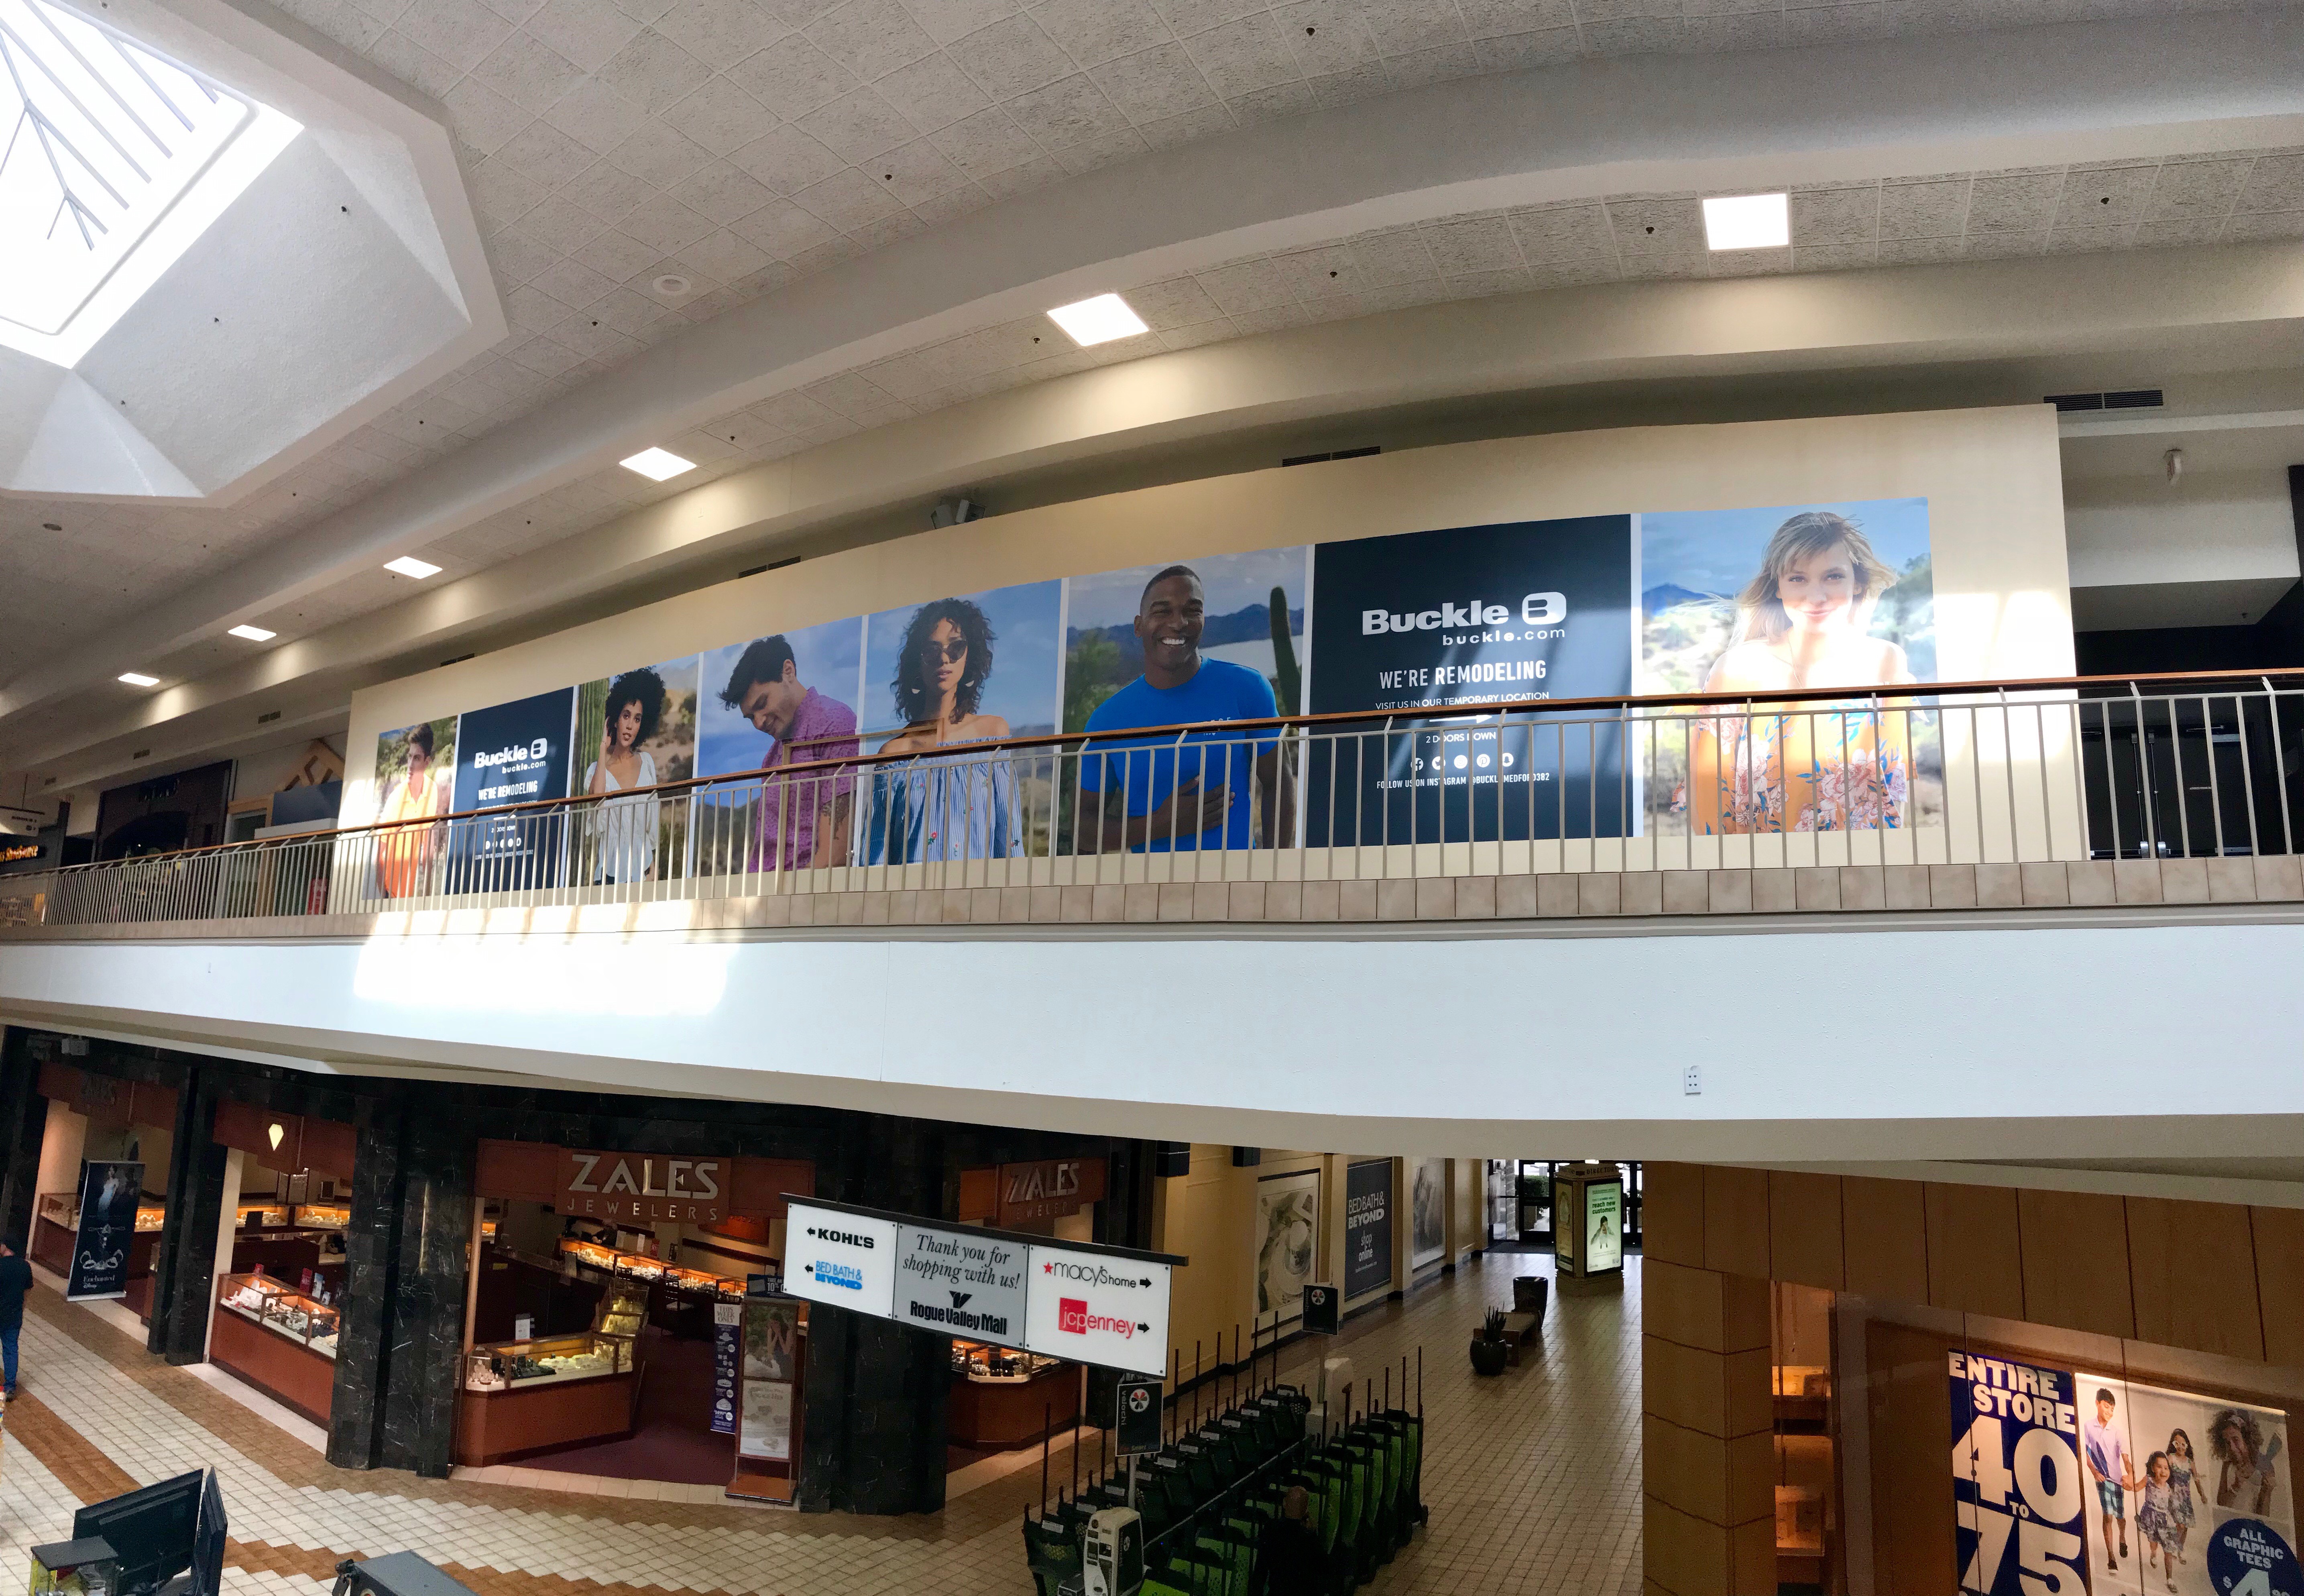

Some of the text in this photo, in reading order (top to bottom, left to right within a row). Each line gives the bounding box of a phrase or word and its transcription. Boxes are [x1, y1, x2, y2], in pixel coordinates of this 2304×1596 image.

[1363, 600, 1508, 635] Buckle
[1443, 628, 1565, 645] buckle.com
[1380, 660, 1546, 689] WE'RE REMODELING
[1376, 702, 1396, 710] VISIT
[1422, 698, 1442, 707] OUR
[1444, 694, 1499, 705] TEMPORARY
[1501, 692, 1549, 702] LOCATION
[474, 745, 527, 768] Buckle
[502, 761, 546, 774] buckle.com
[478, 780, 538, 800] WE'RE REMODELING
[1377, 780, 1402, 789] FOLOW
[1416, 779, 1425, 787] ON
[1427, 777, 1466, 786] INSAGRAM
[568, 1154, 718, 1200] ZALES
[1007, 1163, 1080, 1203] ZALES
[567, 1199, 717, 1220] JEWELERS
[1349, 1191, 1384, 1215] BED BATH &
[1348, 1208, 1384, 1229] BEYOND
[818, 1228, 874, 1248] KOHL'S
[1361, 1230, 1372, 1248] shop
[917, 1234, 1010, 1268] Thank you for
[1359, 1245, 1373, 1262] online
[815, 1272, 862, 1290] BEYOND
[816, 1260, 862, 1280] BED BATH &
[903, 1254, 1020, 1289] shopping with us!
[910, 1300, 1007, 1335] Rogue Valley Mall
[1062, 1306, 1136, 1339] jcpenney
[1948, 1351, 2059, 1400] ENTIRE
[1974, 1387, 2076, 1434] STORE
[1952, 1415, 2081, 1524] 40
[2009, 1500, 2029, 1518] TO
[2240, 1528, 2266, 1544] ALL
[1957, 1500, 2087, 1596] 75
[2223, 1536, 2284, 1560] GRAPHIC
[2237, 1549, 2271, 1569] TEES
